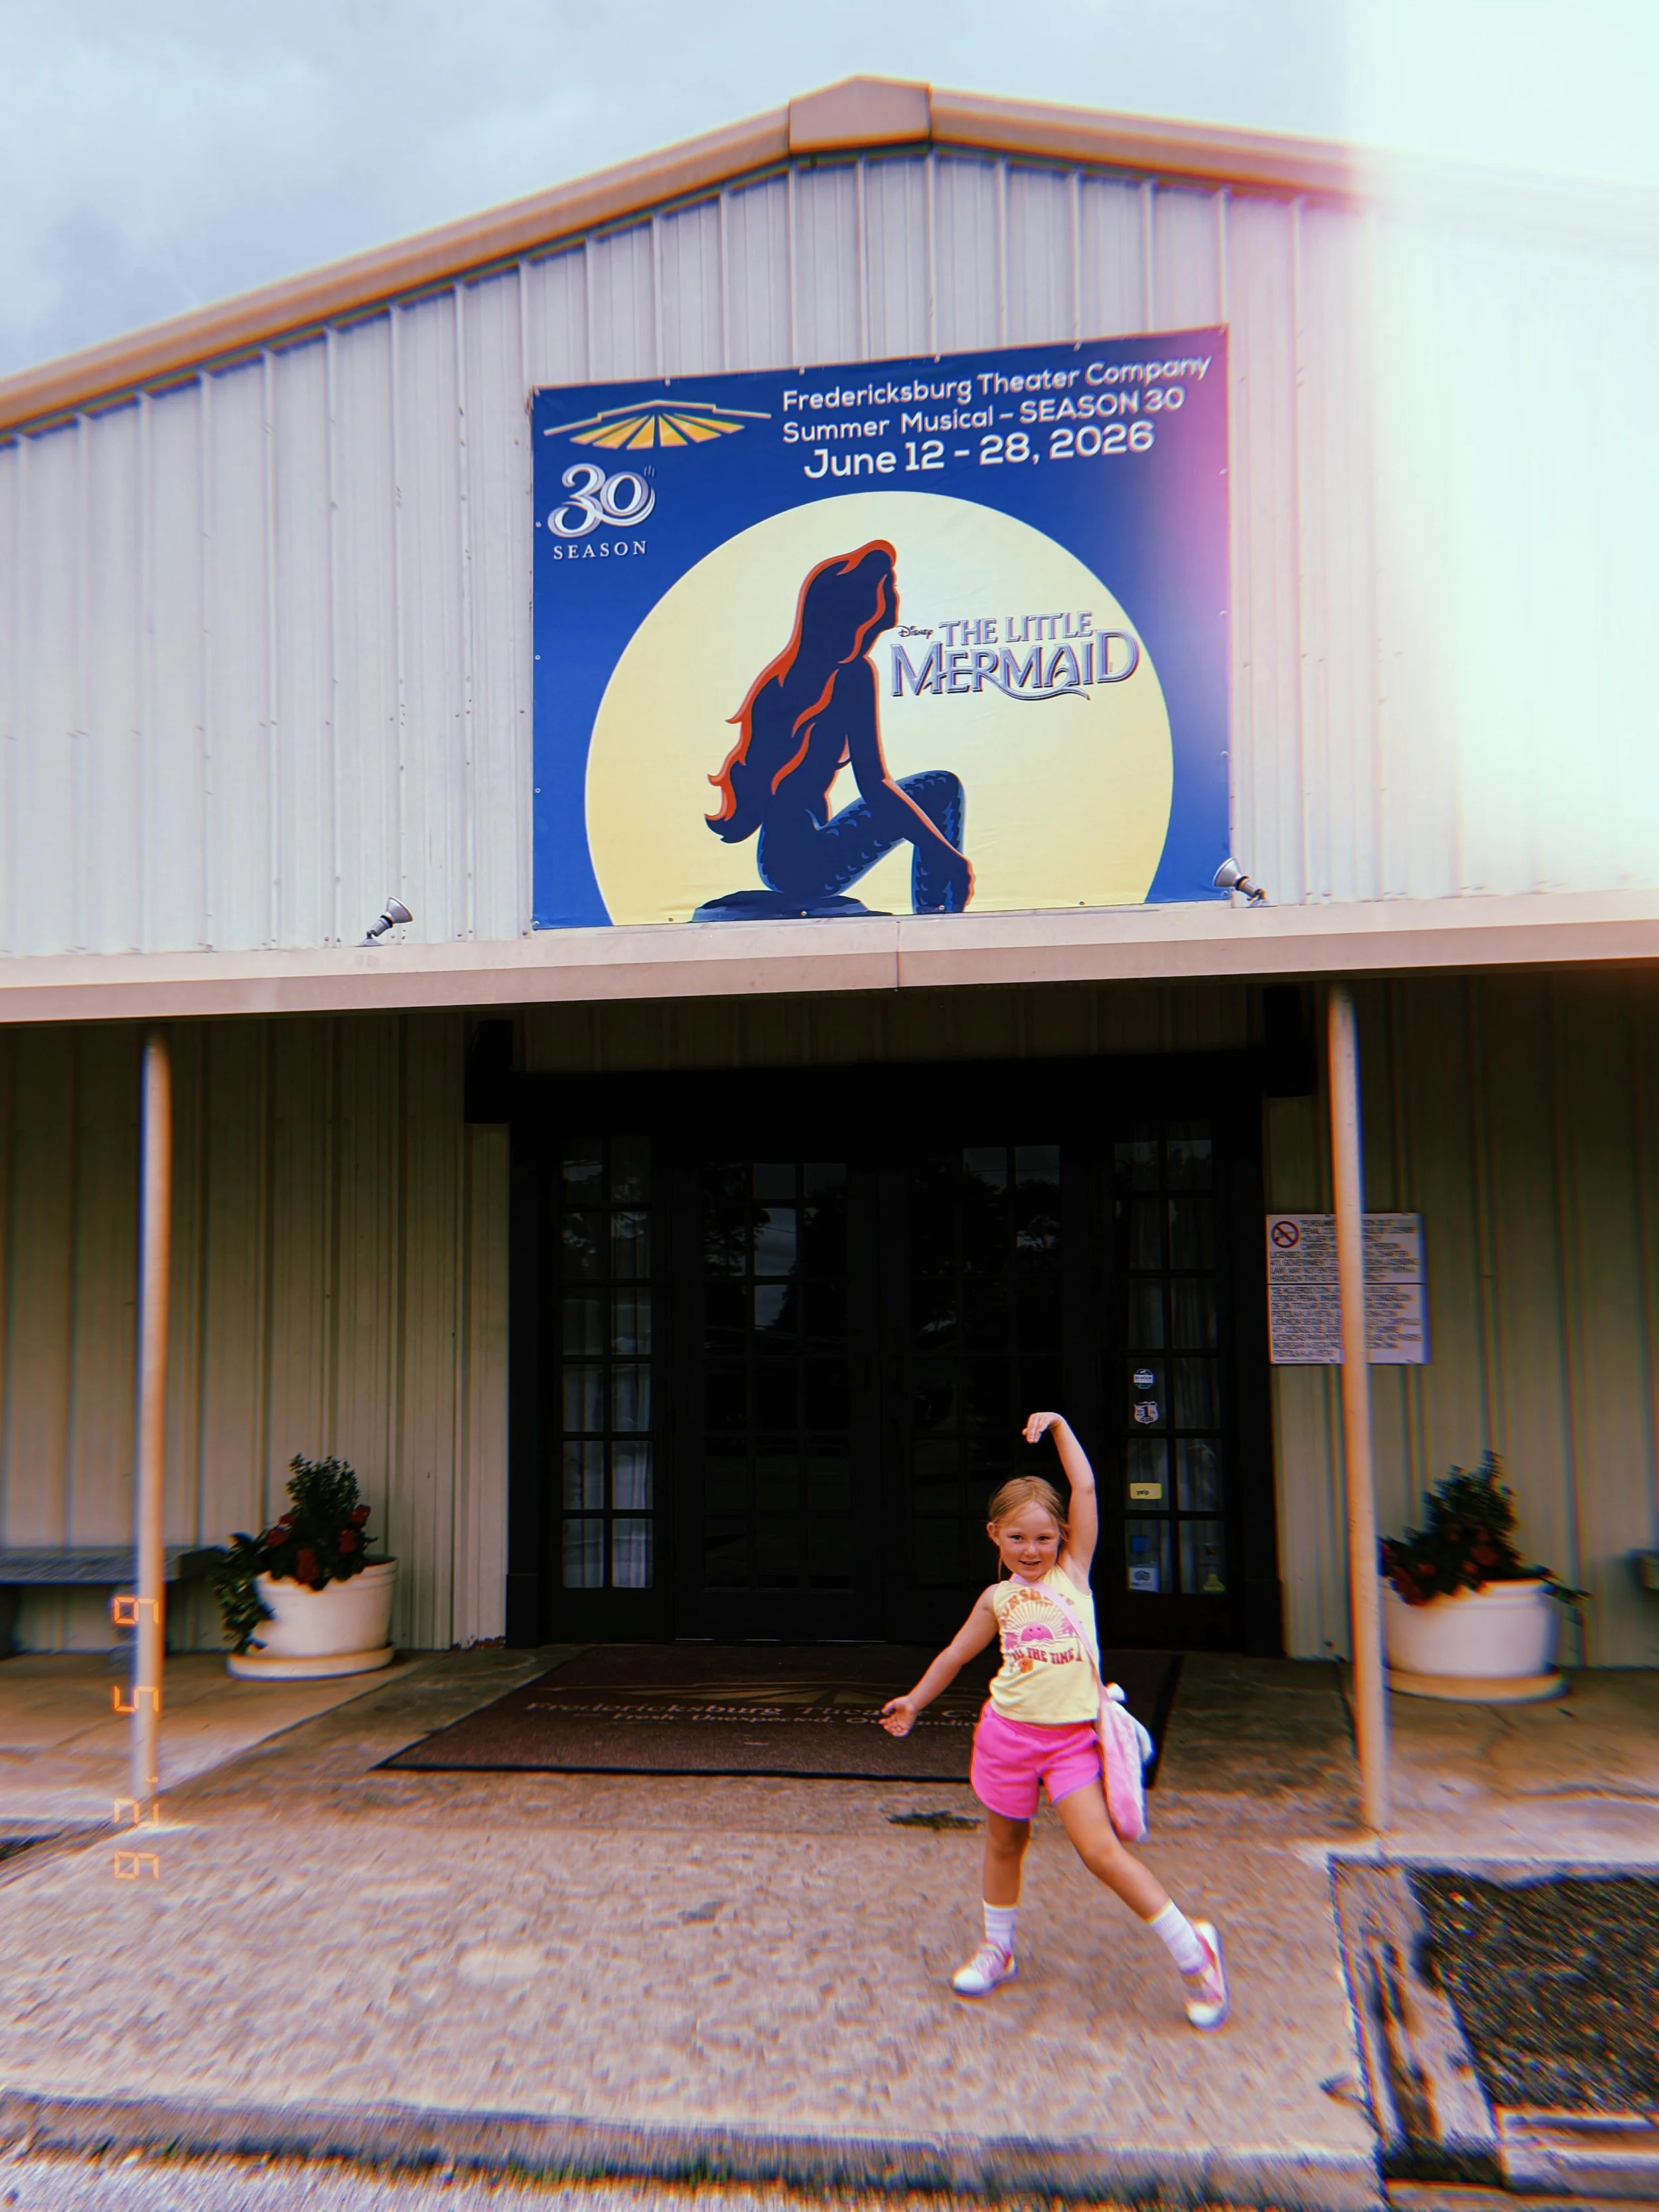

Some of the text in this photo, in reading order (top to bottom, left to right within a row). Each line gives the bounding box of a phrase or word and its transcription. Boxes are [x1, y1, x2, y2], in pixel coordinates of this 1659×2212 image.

[782, 355, 1212, 411] Fredericksburg Theater Company
[782, 417, 890, 443] Summer
[902, 406, 993, 434] Musical
[1019, 390, 1139, 424] SEASON
[1143, 386, 1185, 412] 30
[804, 447, 897, 479] June
[905, 440, 945, 472] 12
[979, 431, 1039, 465] 28,
[1049, 419, 1155, 460] 2026
[553, 540, 646, 560] SEASON
[939, 611, 1094, 647] THE LITTLE
[890, 628, 1140, 701] MERMAID
[1026, 1647, 1048, 1663] THE
[1049, 1647, 1074, 1665] TIME
